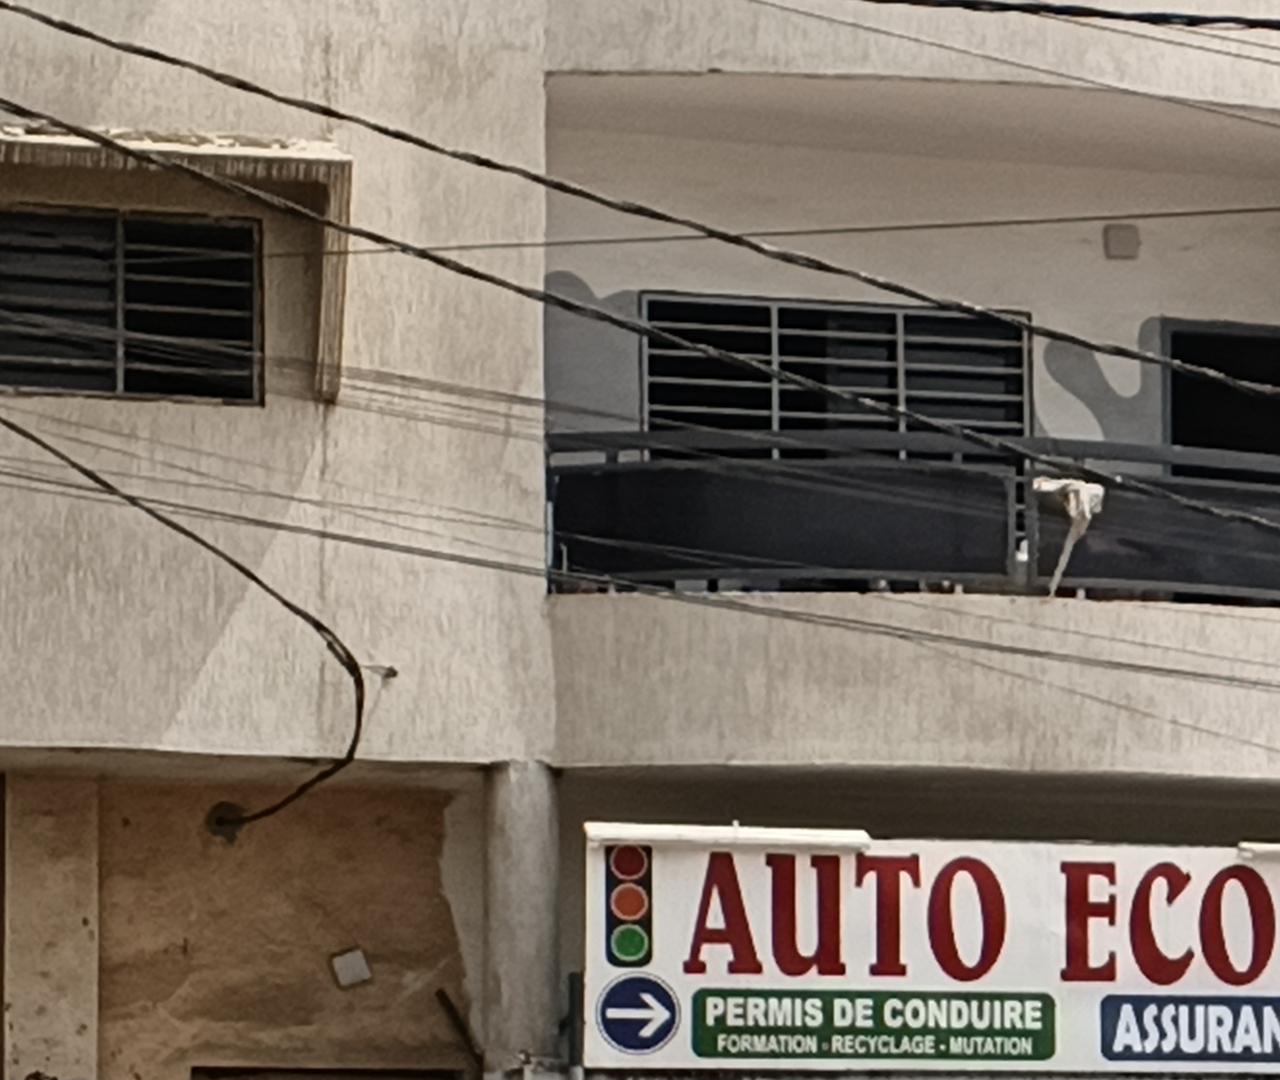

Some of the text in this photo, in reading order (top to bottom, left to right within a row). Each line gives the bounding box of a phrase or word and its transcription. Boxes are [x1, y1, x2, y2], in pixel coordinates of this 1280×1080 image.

[683, 851, 1007, 983] AUTO
[705, 996, 1043, 1030] PERMIS DE CONDUIRE
[716, 1033, 1033, 1056] FORMATION RECYCLAGE MUTATION
